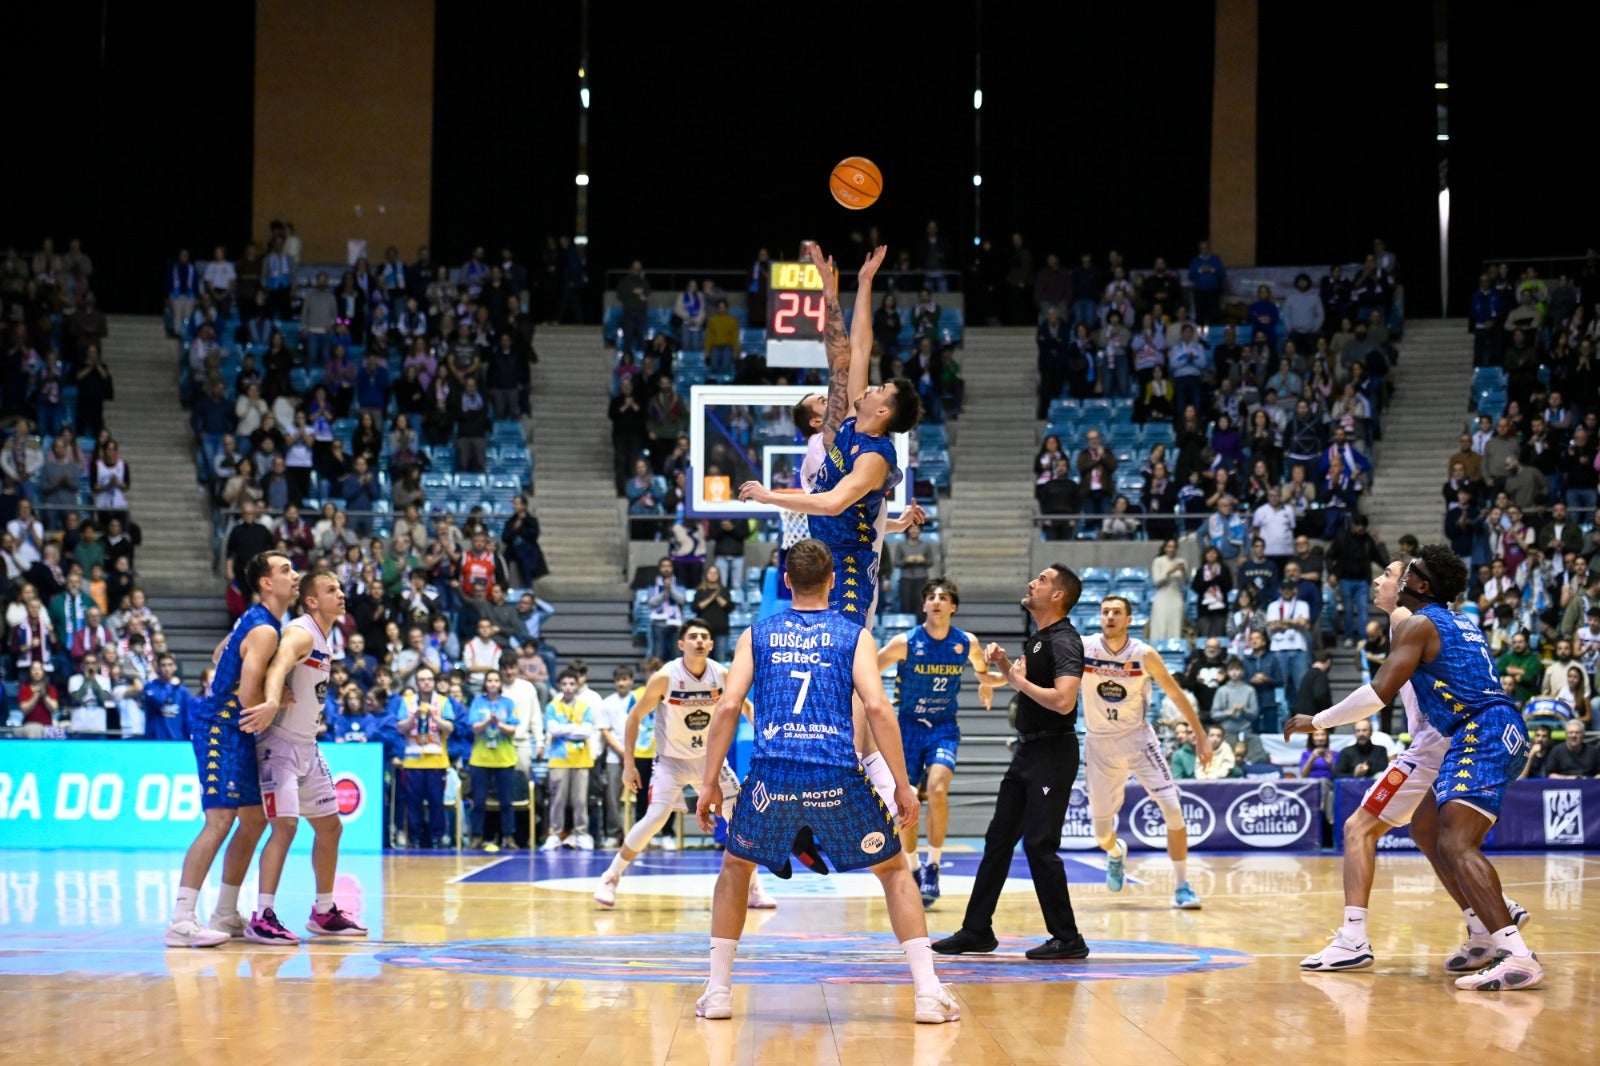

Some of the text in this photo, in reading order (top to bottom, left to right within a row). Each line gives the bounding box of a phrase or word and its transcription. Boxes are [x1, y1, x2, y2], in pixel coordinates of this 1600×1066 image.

[774, 293, 826, 333] 24
[821, 632, 834, 647] D.
[790, 670, 812, 714] 7
[933, 677, 948, 692] 22
[783, 723, 839, 735] CAJA RURAL
[691, 735, 703, 748] 24
[54, 773, 124, 820] DO
[135, 774, 206, 821] OB
[769, 788, 844, 802] URIA MOTOR
[802, 800, 842, 808] OVIEDO
[1238, 801, 1300, 818] Estrella
[1142, 804, 1204, 820] Eslla
[1241, 817, 1298, 834] Galicia
